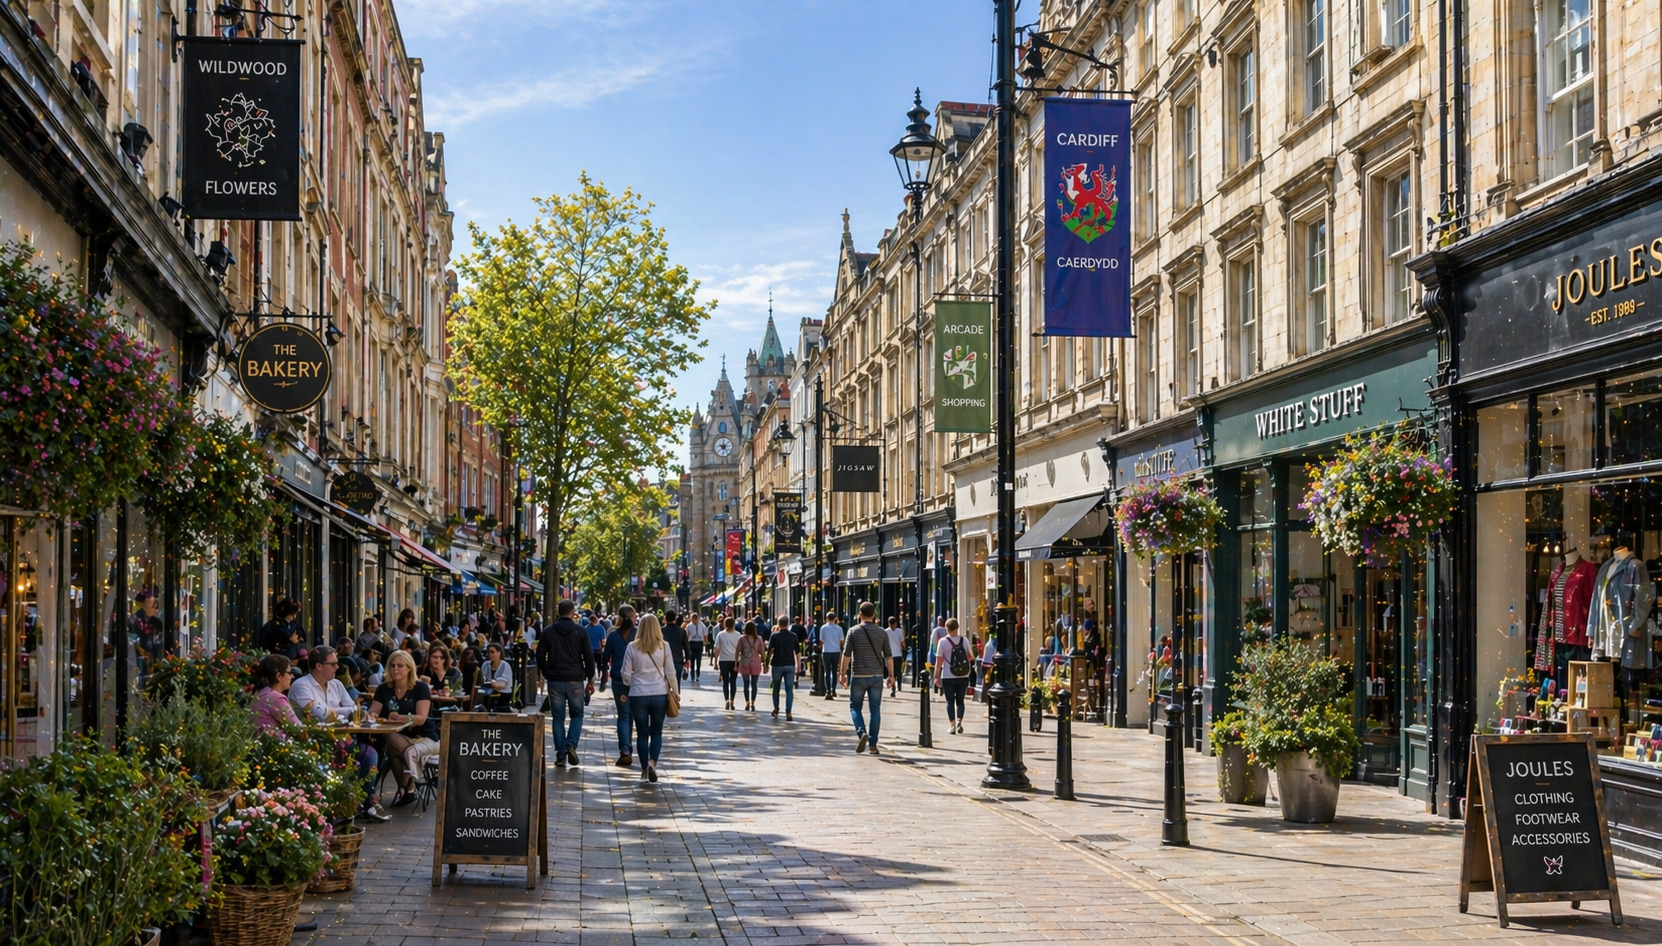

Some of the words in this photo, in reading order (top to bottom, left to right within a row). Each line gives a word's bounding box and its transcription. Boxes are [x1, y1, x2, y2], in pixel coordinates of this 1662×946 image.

[198, 59, 287, 76] WILDWOOD
[1056, 131, 1119, 148] CARDIFF
[205, 180, 277, 196] FLOWERS
[1056, 256, 1119, 270] CAERDYDD
[1551, 236, 1662, 312] JOULES
[1590, 307, 1611, 326] EST.
[943, 324, 984, 335] ARCADE
[273, 344, 297, 356] THE
[247, 360, 323, 378] BAKERY
[941, 397, 986, 408] SHOPPING
[1254, 400, 1305, 438] WHITE
[1309, 382, 1366, 425] STUFF
[837, 464, 875, 472] JIGSAW
[481, 729, 502, 740] THE
[459, 741, 523, 757] BAKERY
[470, 769, 509, 781] COFFEE
[1506, 760, 1574, 777] JOULES
[475, 789, 502, 800] CAKE
[1514, 791, 1575, 805] CLOTHING
[464, 807, 513, 819] PASTRIES
[1515, 812, 1581, 826] FOOTWEAR
[455, 827, 519, 839] SANDWICHES
[1511, 831, 1591, 846] ACCESSORIES
